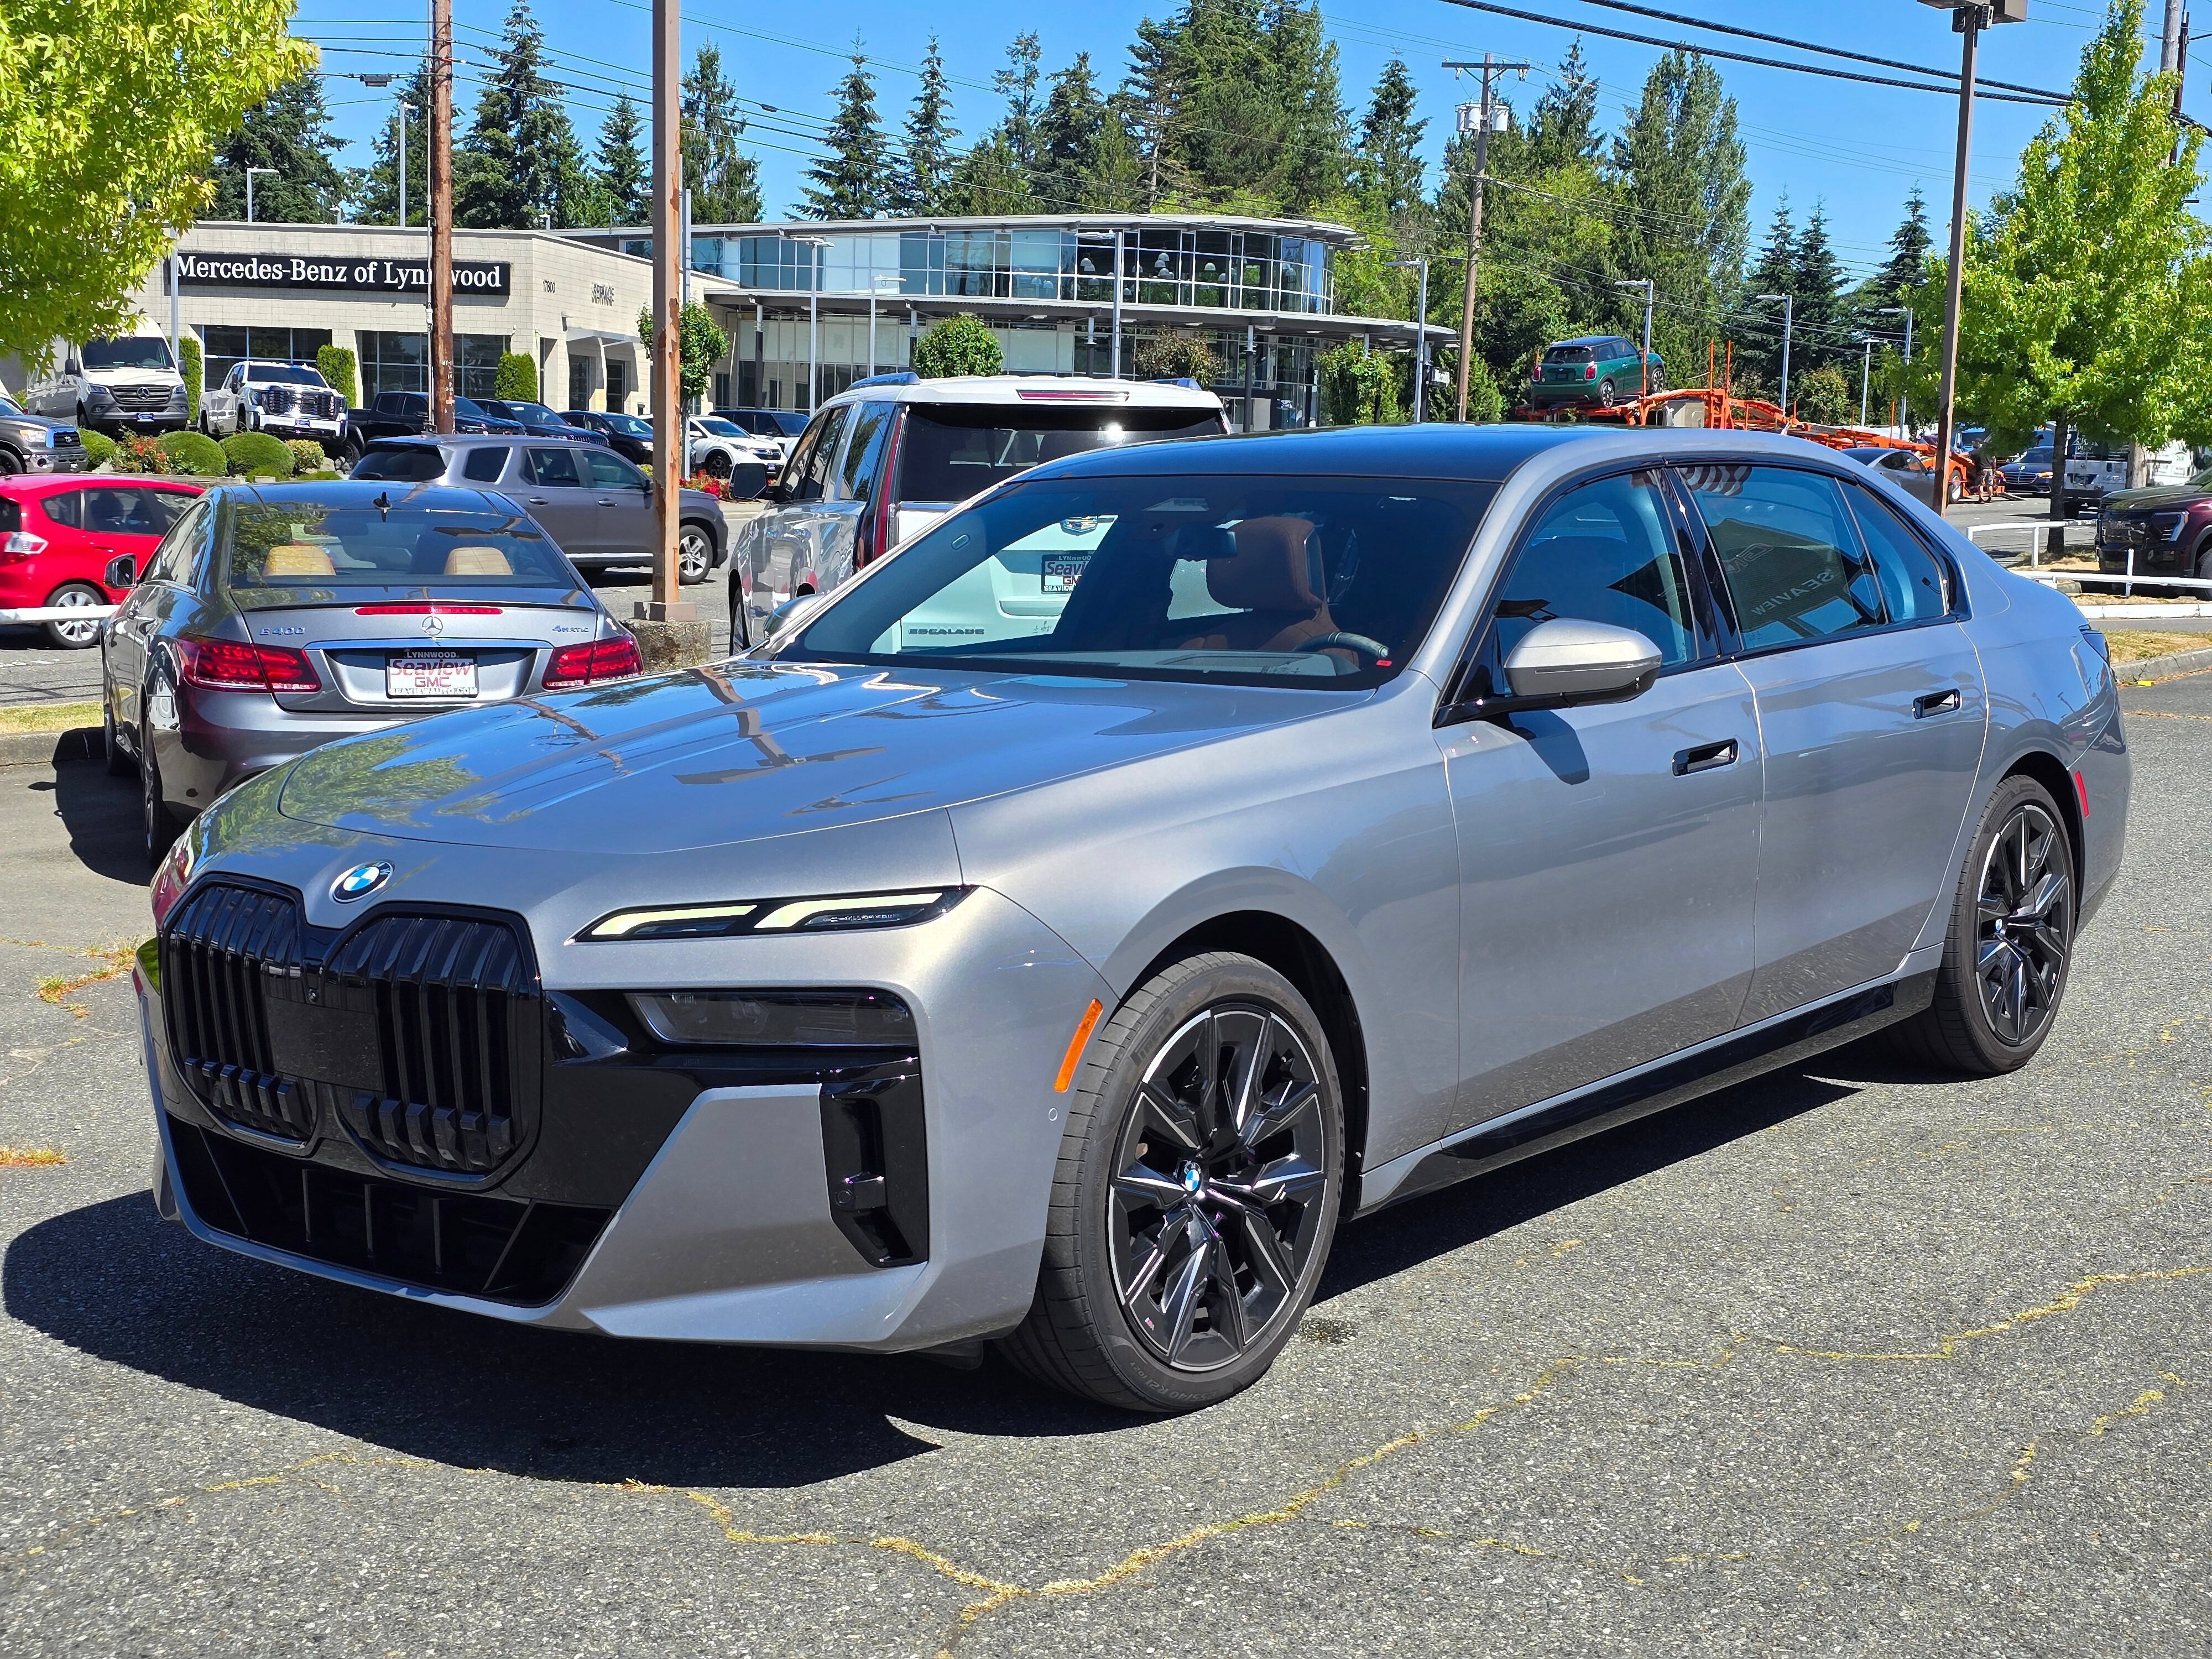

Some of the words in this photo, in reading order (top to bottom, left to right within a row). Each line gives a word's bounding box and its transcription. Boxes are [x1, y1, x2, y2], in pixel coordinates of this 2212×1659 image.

[176, 255, 347, 282] Mercedes-Benz
[354, 261, 378, 283] of
[384, 262, 502, 289] Lynood
[543, 280, 556, 294] 17800
[1045, 561, 1086, 575] Seavi
[1063, 575, 1083, 585] GM
[272, 626, 306, 635] 400
[392, 659, 473, 676] Seaview
[414, 676, 452, 687] GMC
[1145, 1379, 1170, 1395] R21
